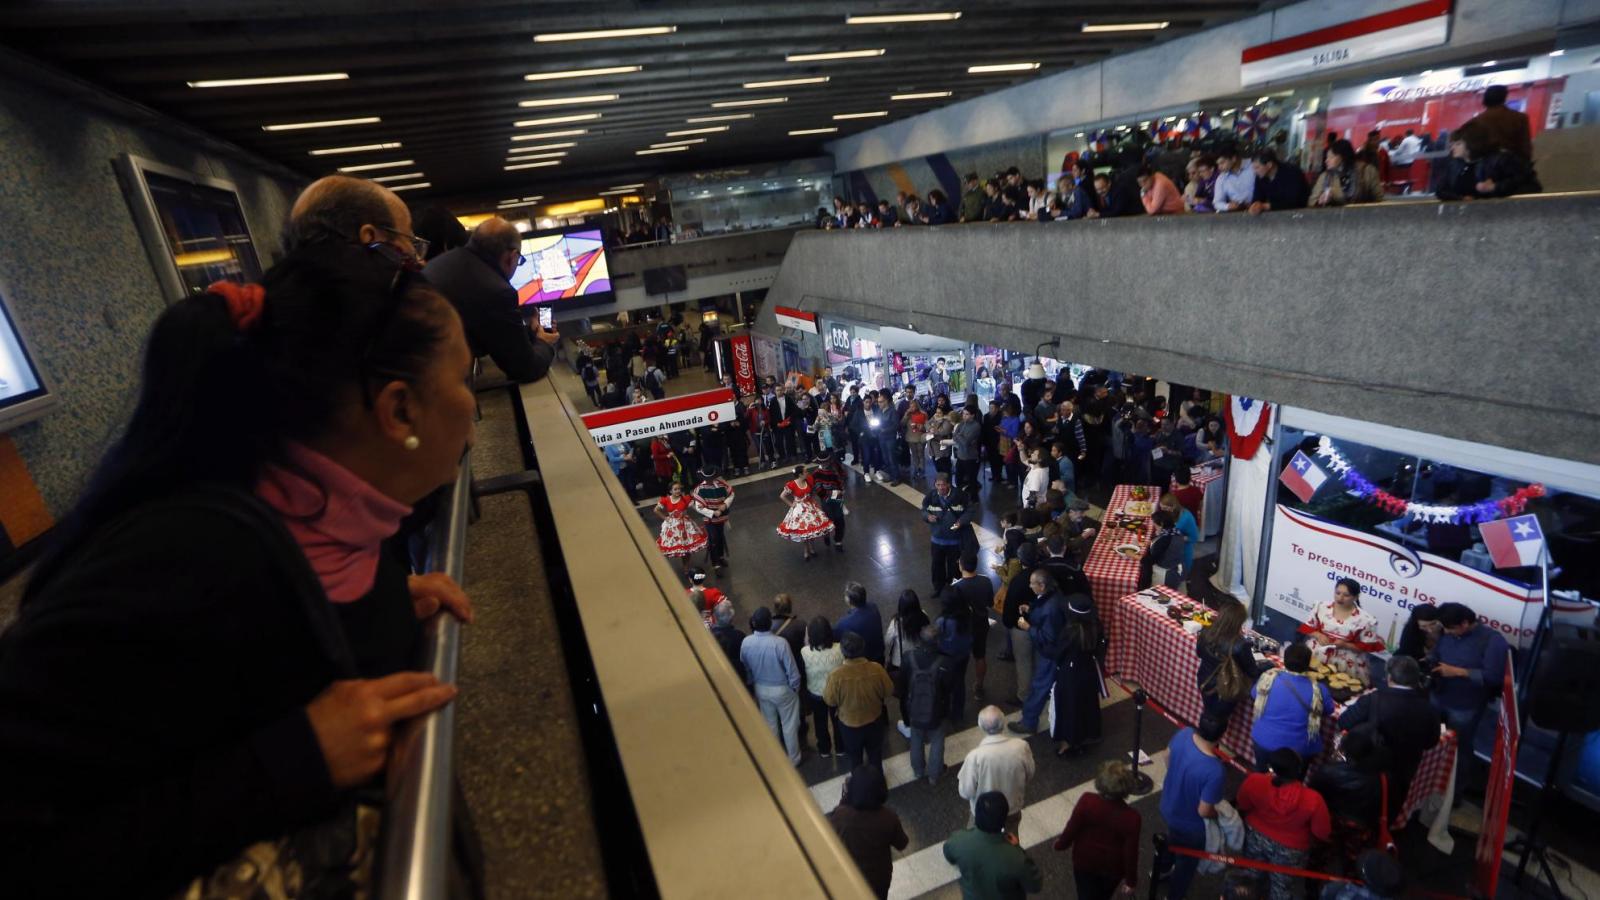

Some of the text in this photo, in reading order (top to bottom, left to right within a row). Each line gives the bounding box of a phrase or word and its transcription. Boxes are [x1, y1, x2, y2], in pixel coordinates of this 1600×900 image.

[1312, 48, 1350, 66] SALIDA
[616, 432, 622, 440] a
[625, 427, 656, 438] Paseo
[659, 415, 704, 431] Ahumada
[1291, 543, 1437, 607] Te presentamos a los
[1360, 584, 1393, 603] ebre
